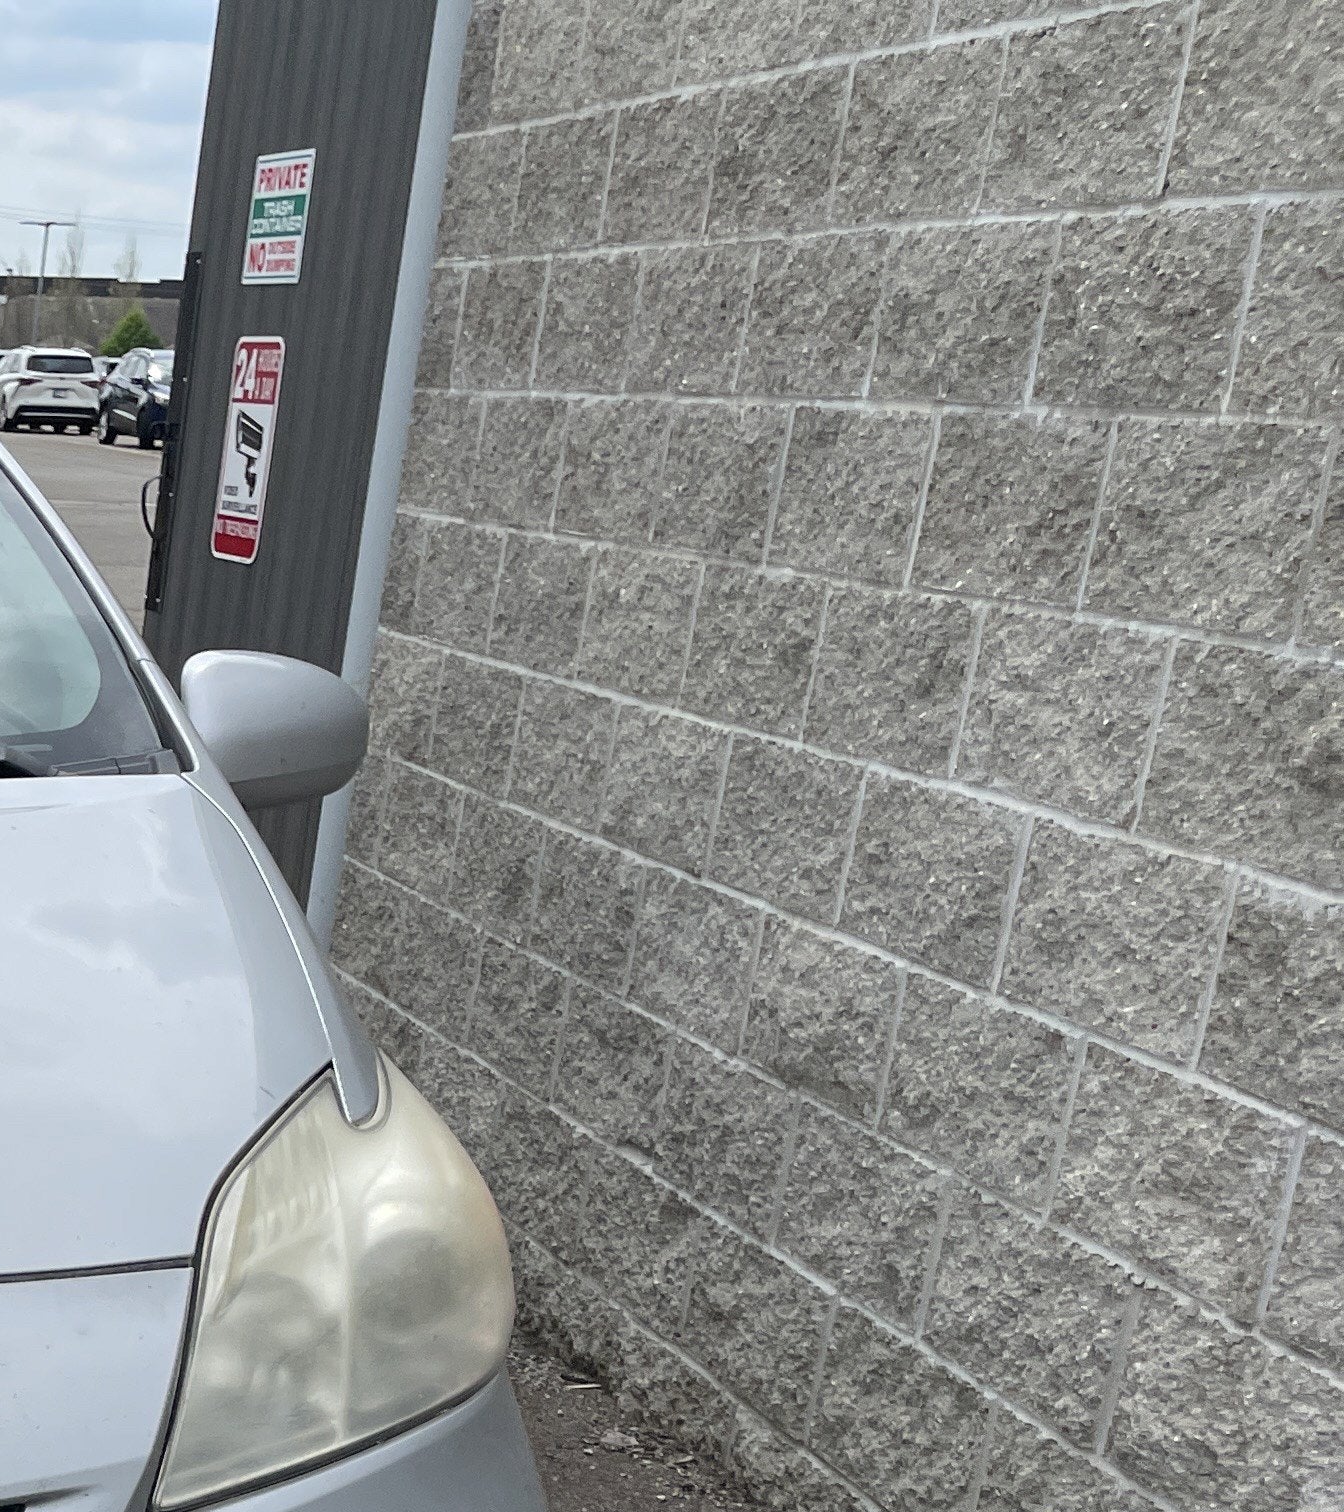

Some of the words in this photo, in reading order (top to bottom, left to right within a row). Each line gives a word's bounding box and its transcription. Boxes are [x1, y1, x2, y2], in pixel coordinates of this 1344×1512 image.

[258, 163, 309, 193] PRIVATE
[247, 242, 268, 273] NO
[233, 348, 259, 400] 24
